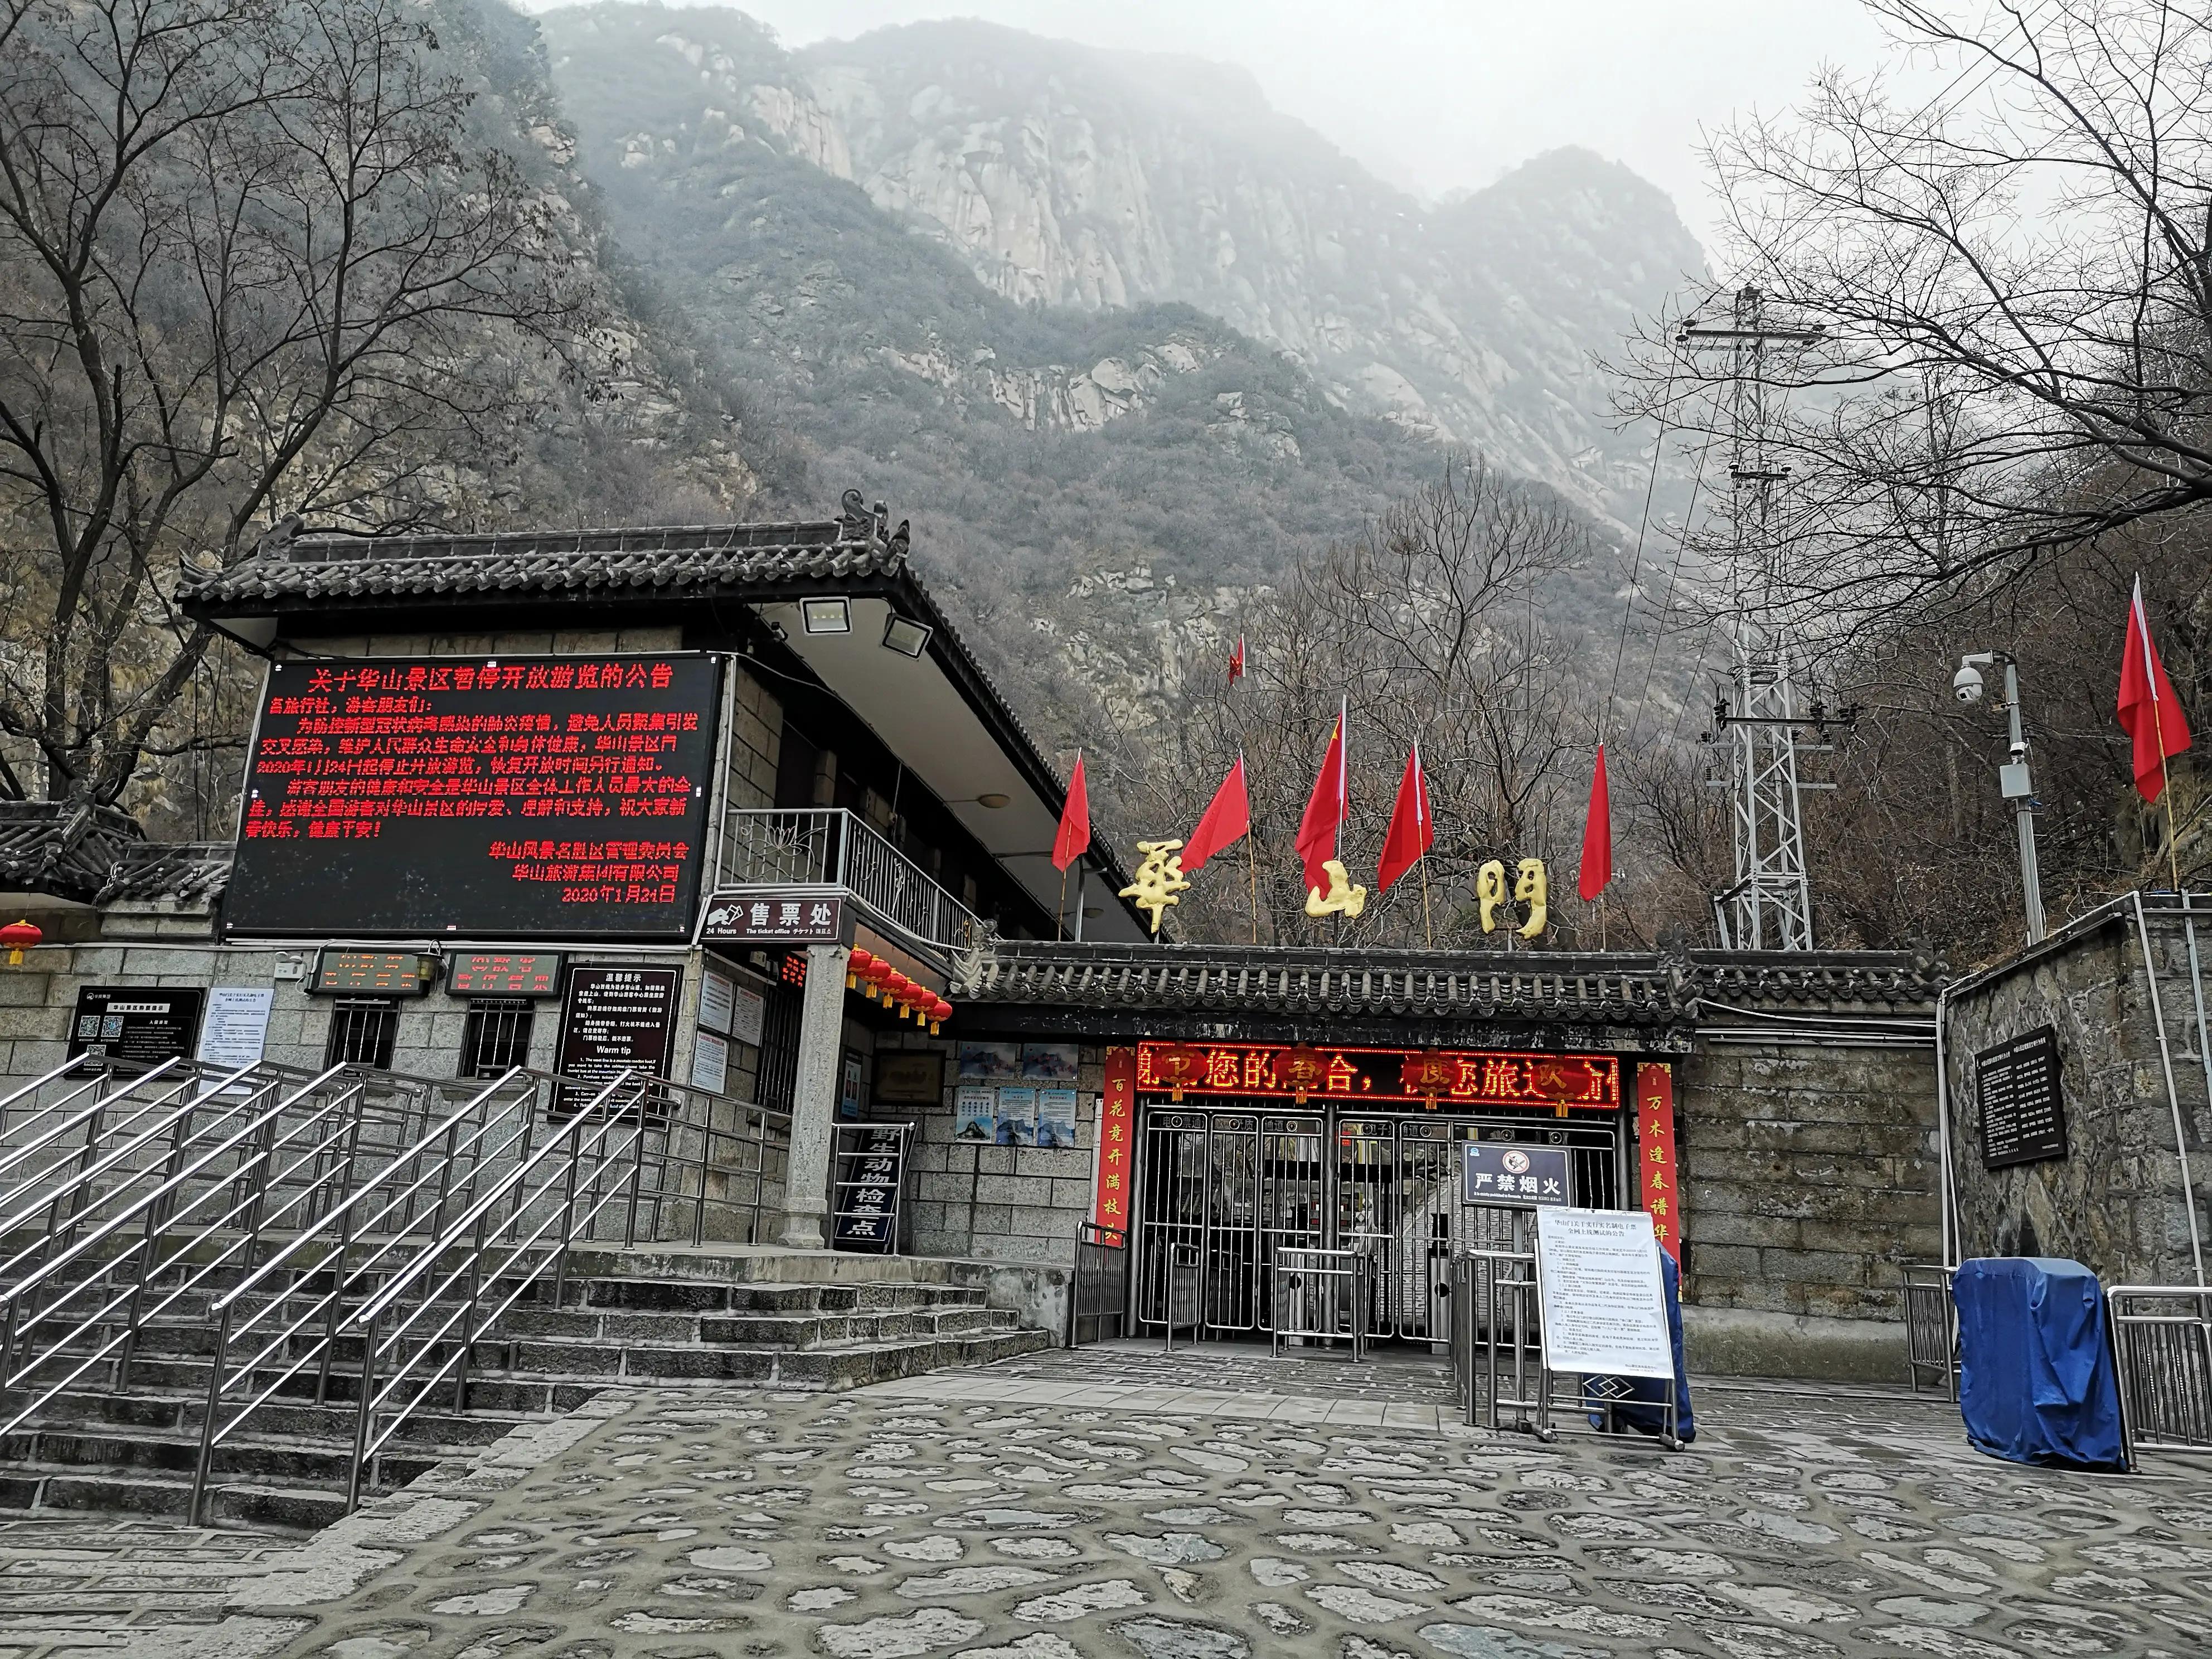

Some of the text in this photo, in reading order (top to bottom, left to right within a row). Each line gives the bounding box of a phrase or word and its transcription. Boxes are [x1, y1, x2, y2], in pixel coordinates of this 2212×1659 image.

[750, 903, 832, 926] 售票处
[596, 1045, 631, 1055] Warm tip
[1288, 1053, 1322, 1080] 春
[1420, 1058, 1450, 1084] 度
[1537, 1060, 1567, 1089] 欢
[1475, 1172, 1561, 1195] 严禁烟火
